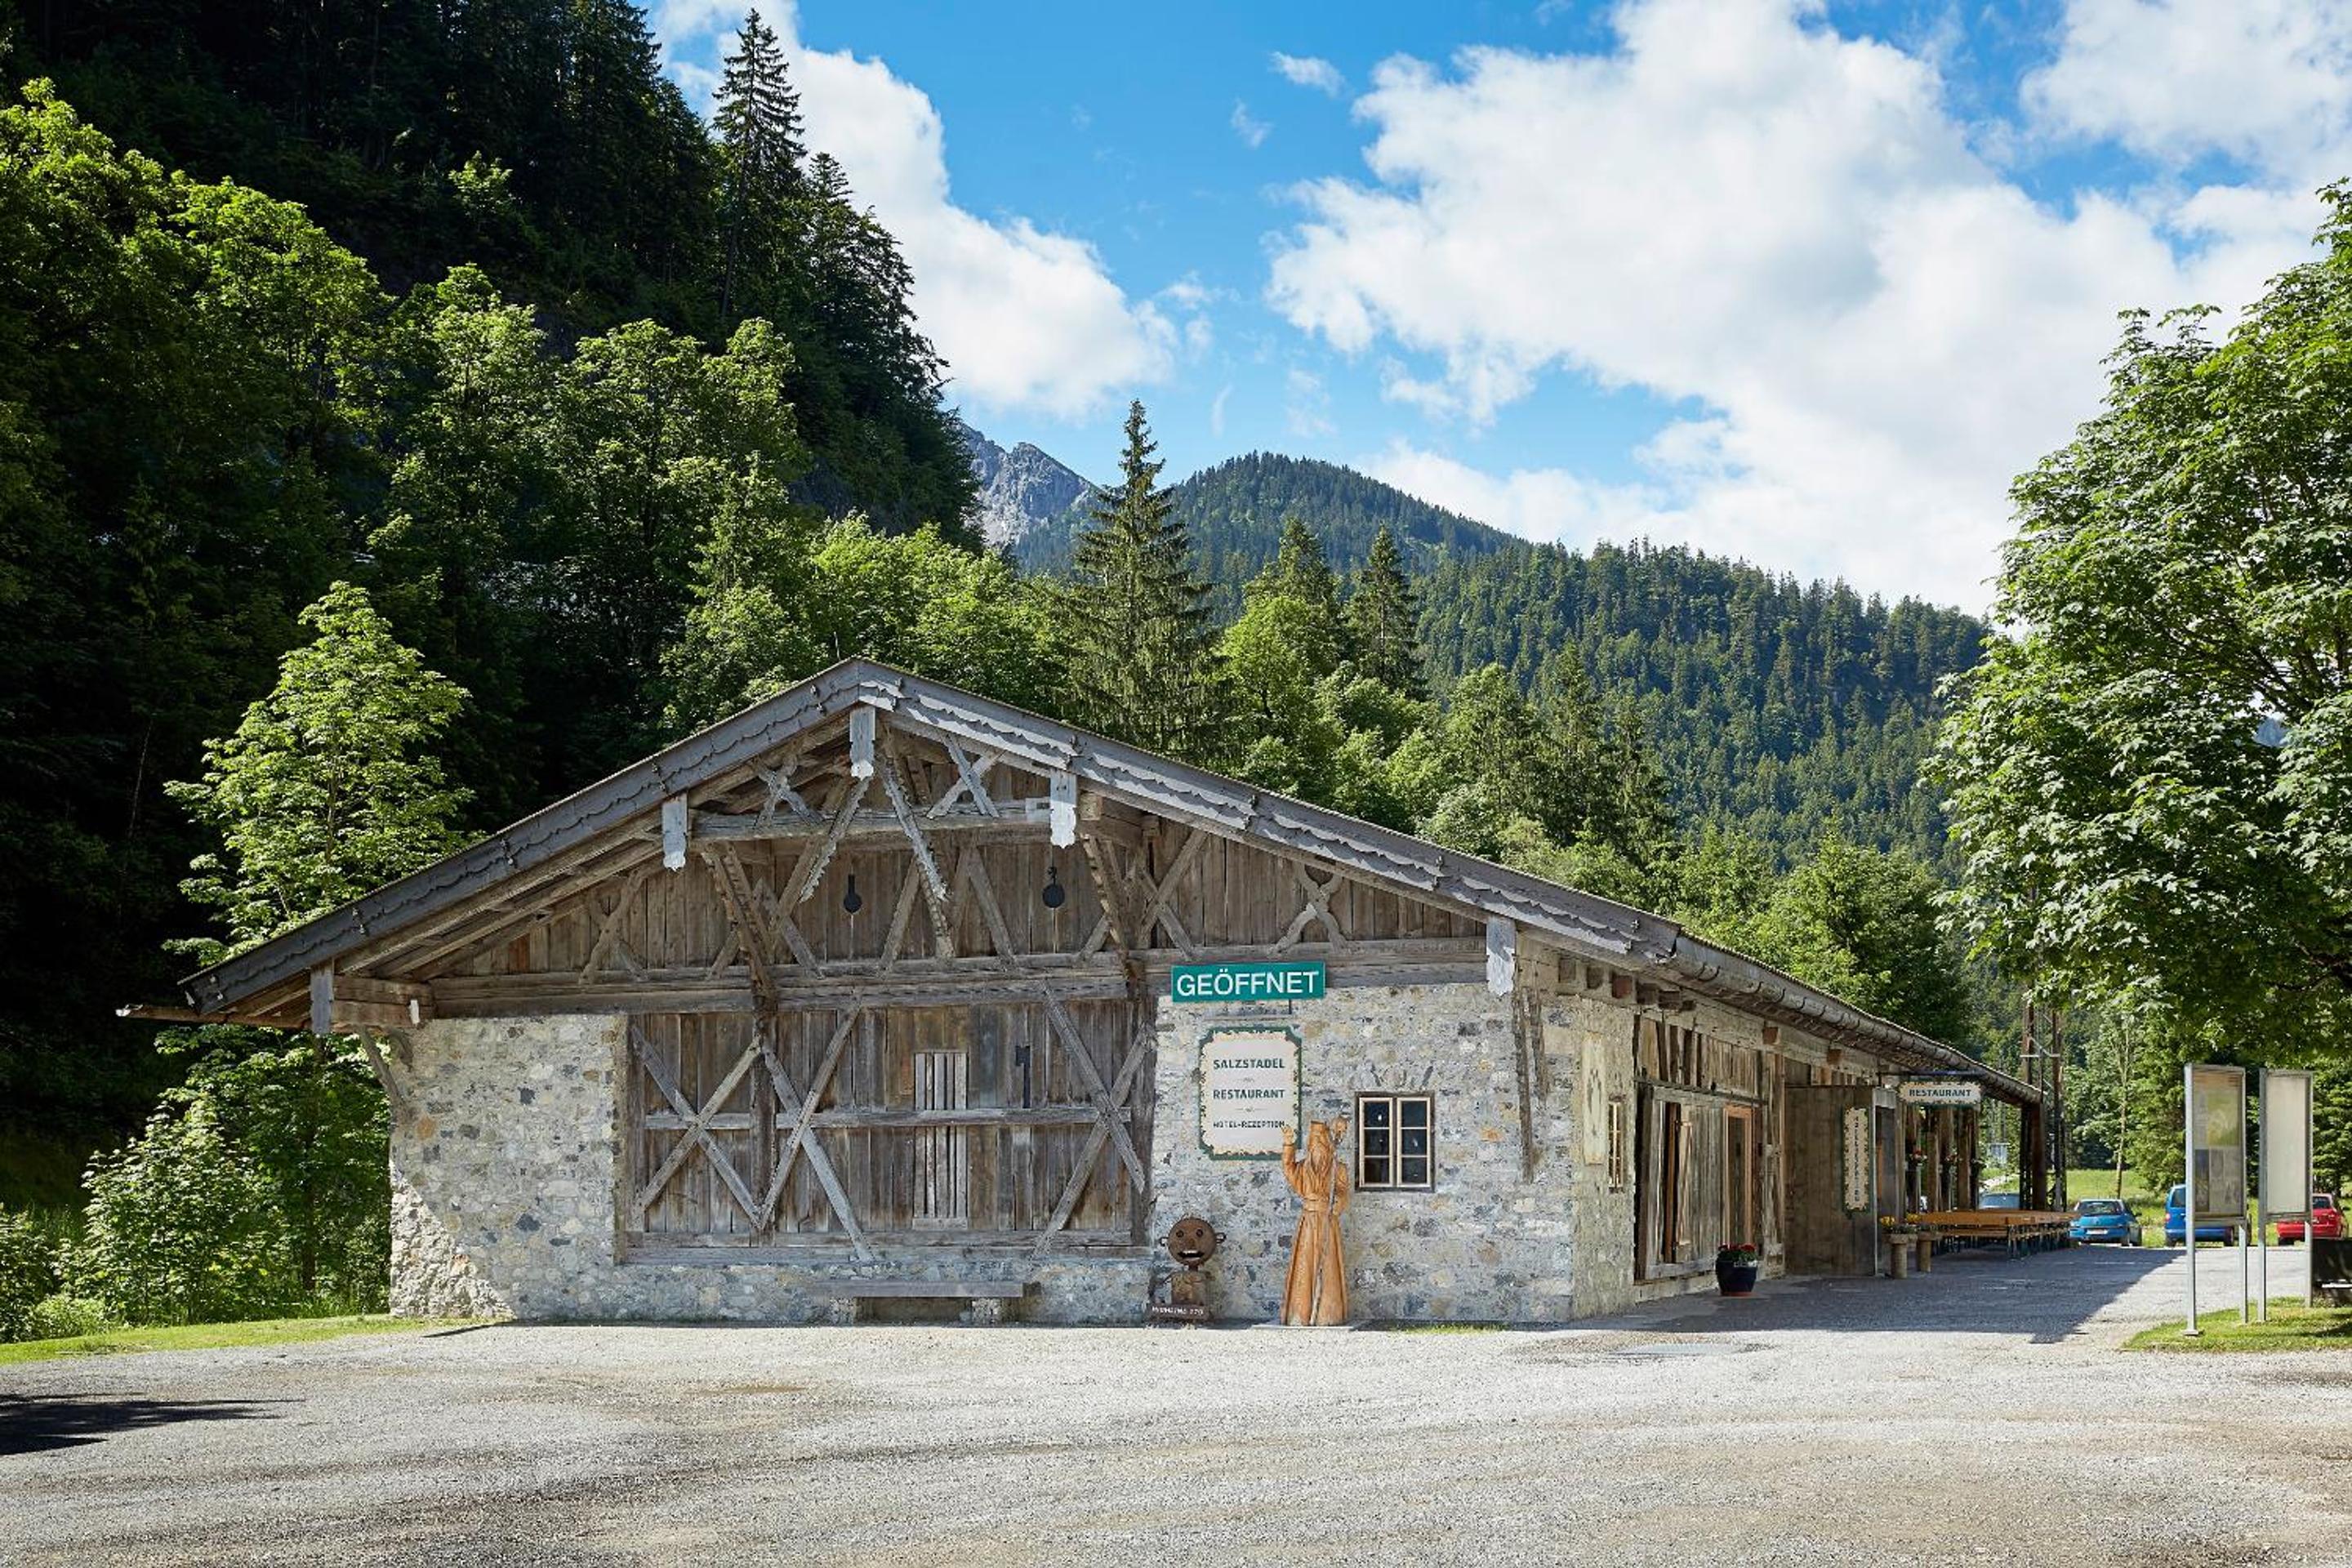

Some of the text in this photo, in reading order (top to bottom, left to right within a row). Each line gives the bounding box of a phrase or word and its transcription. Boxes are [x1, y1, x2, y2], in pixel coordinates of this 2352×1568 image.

[1176, 969, 1320, 996] GEÖFFNET
[1213, 1058, 1285, 1070] SALZSTADEL
[1213, 1089, 1285, 1100] RESTAURANT
[1909, 1089, 1971, 1097] RESTAURANT
